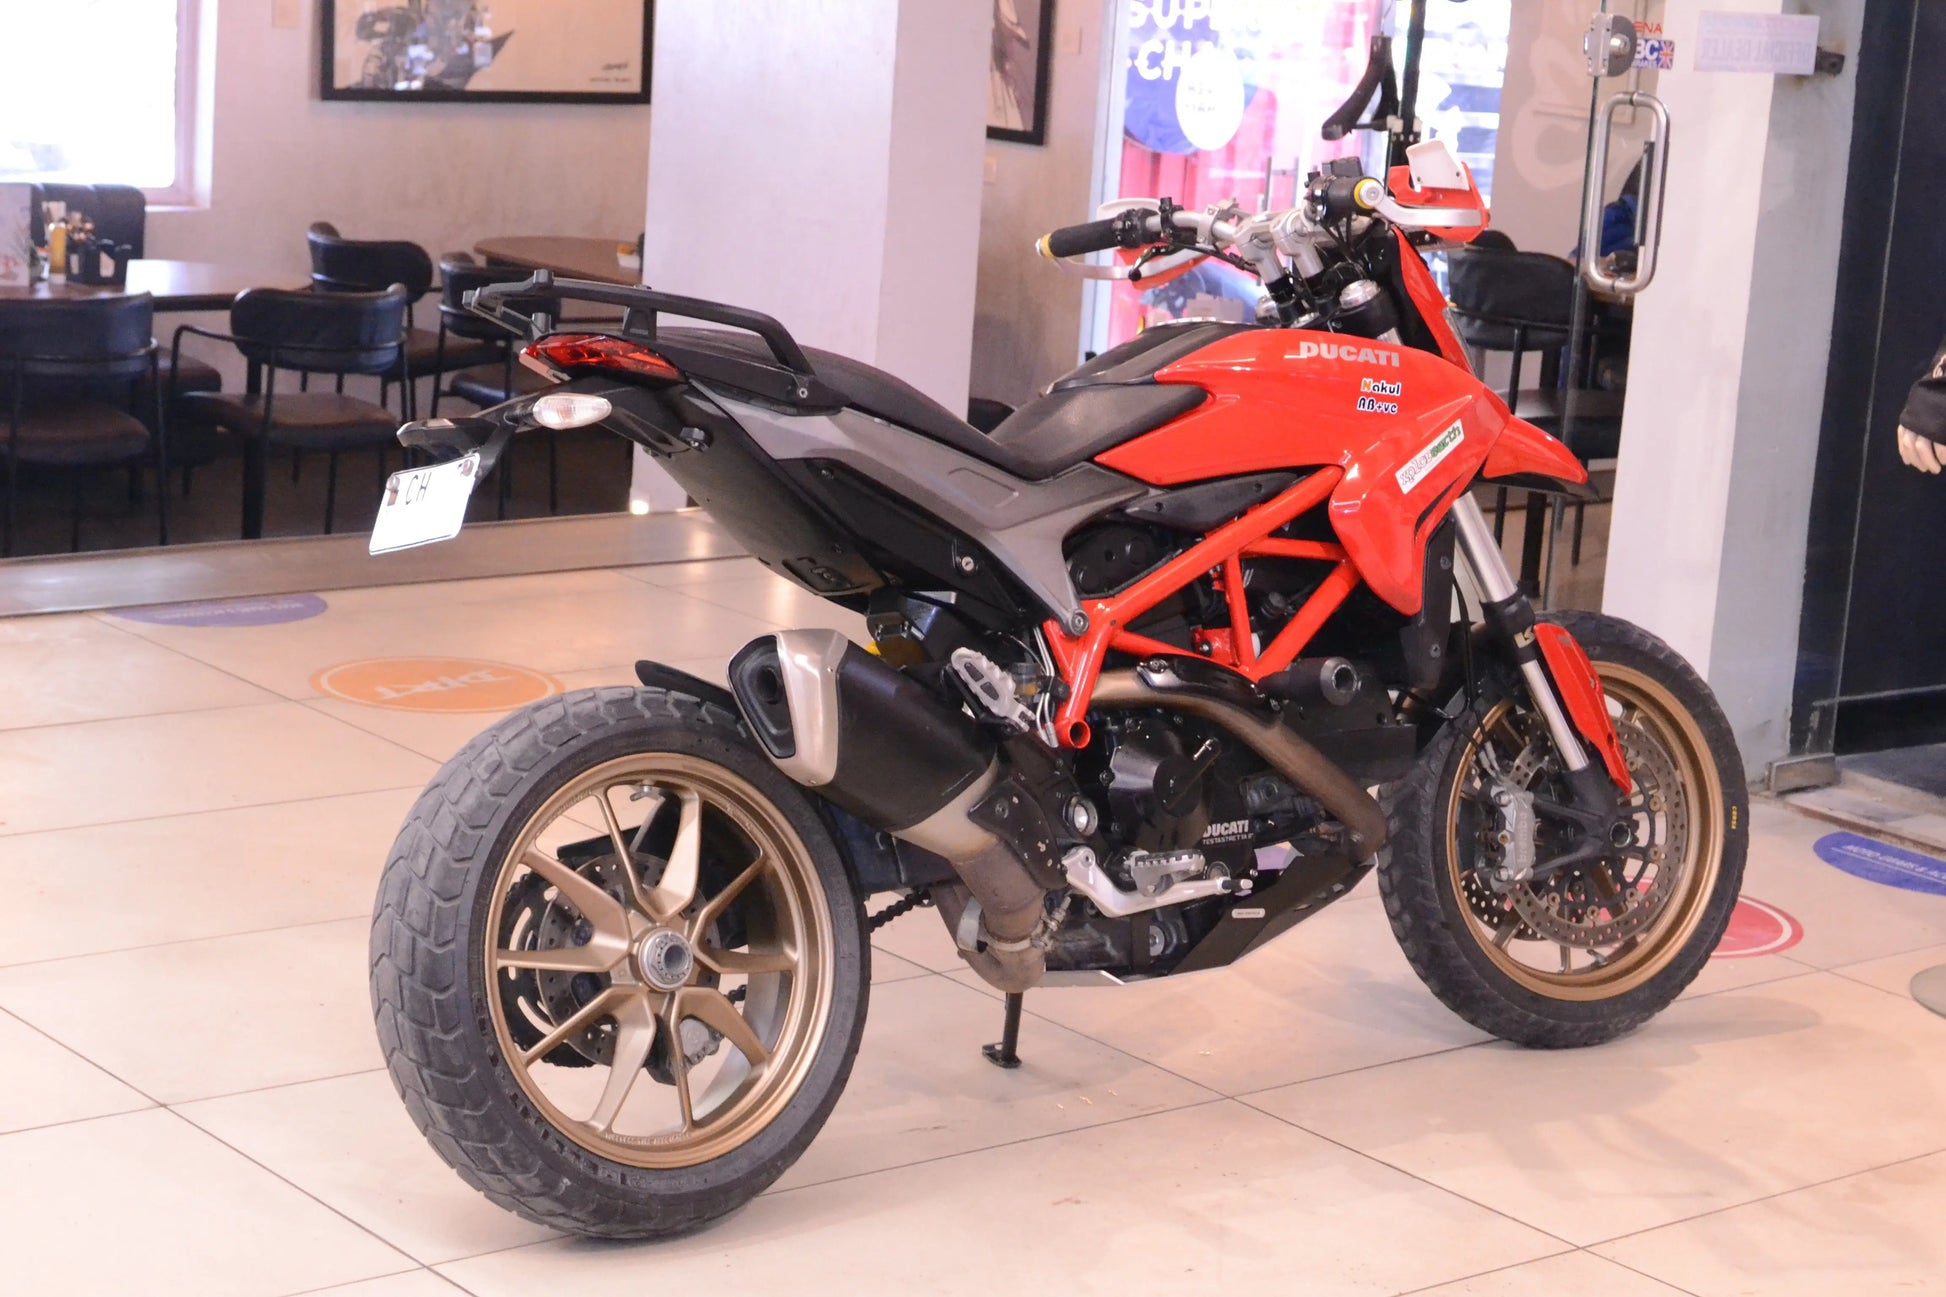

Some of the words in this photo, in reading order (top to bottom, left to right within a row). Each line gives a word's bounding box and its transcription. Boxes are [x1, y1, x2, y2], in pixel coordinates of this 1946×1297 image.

[1634, 39, 1659, 60] BC
[1299, 341, 1400, 367] DUCATI
[1361, 379, 1401, 395] Nakul
[1203, 820, 1249, 838] DUCATI
